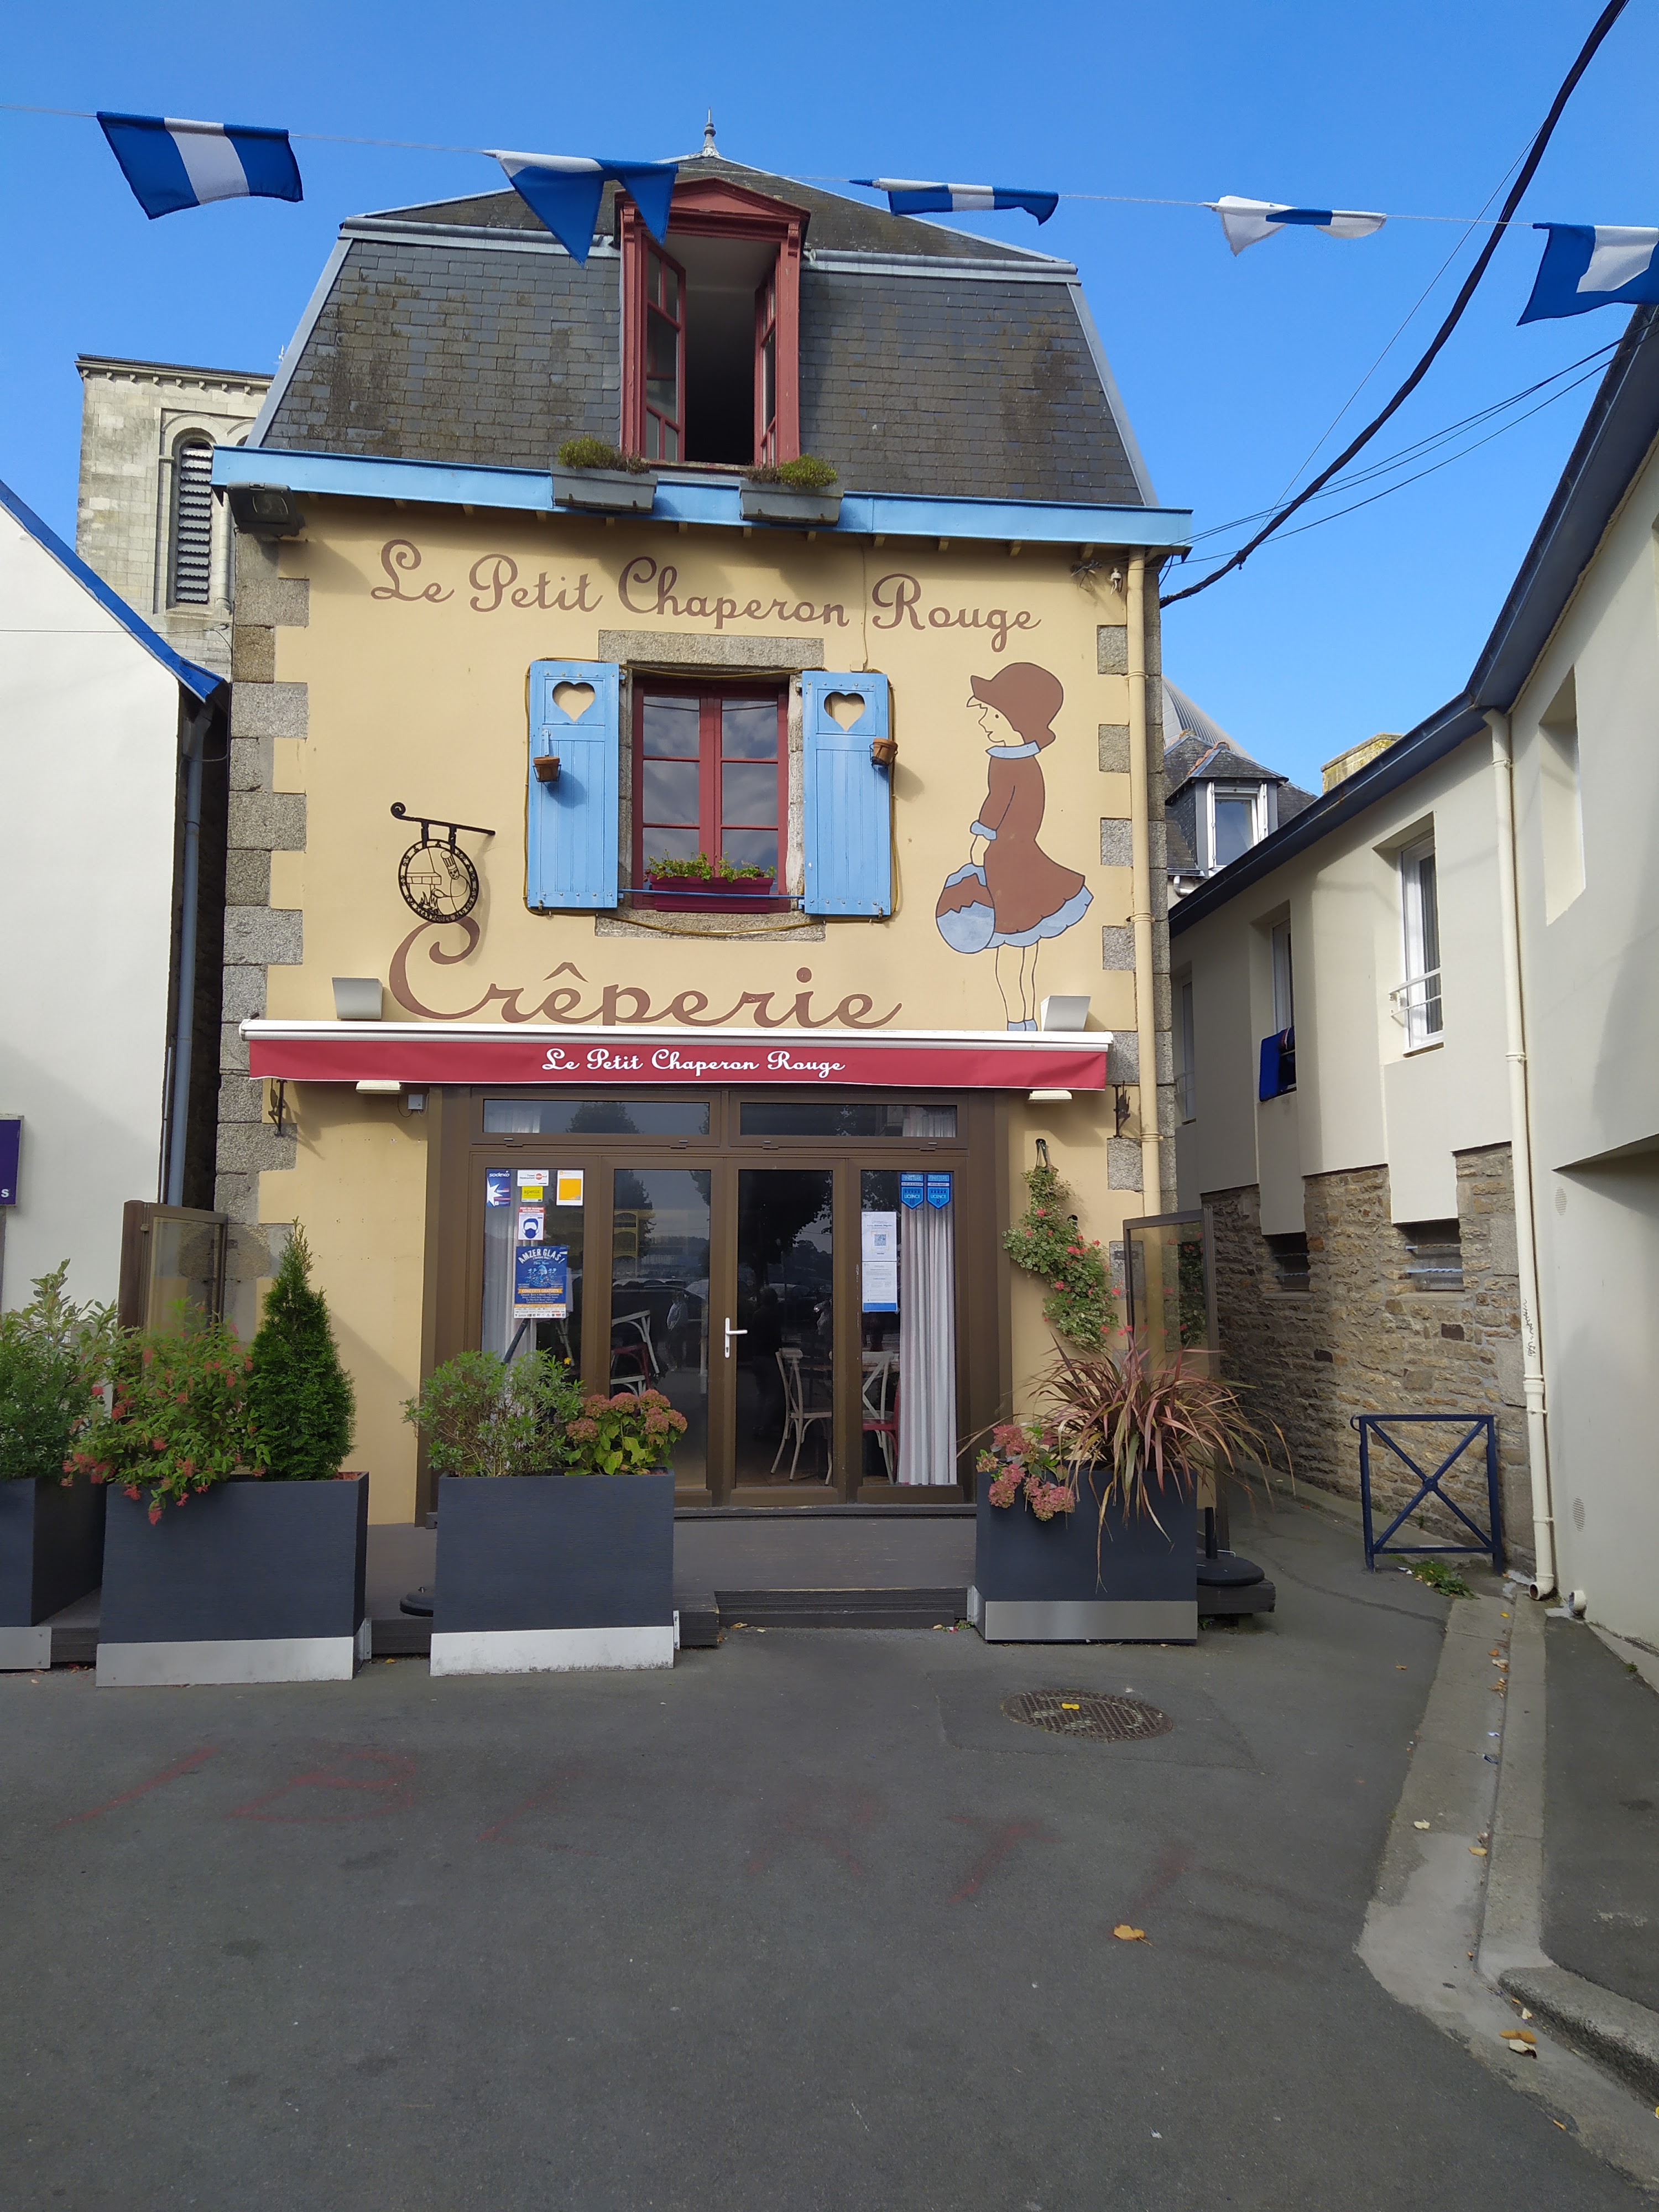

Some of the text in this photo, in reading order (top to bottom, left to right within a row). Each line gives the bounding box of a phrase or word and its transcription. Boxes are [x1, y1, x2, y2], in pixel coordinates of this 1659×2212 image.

[371, 538, 1042, 653] Le Petit Chaperon Rouge
[388, 918, 902, 1029] Crêperie
[541, 1048, 846, 1079] Le Petit Chaperon Rouge
[518, 1248, 541, 1264] AMZER
